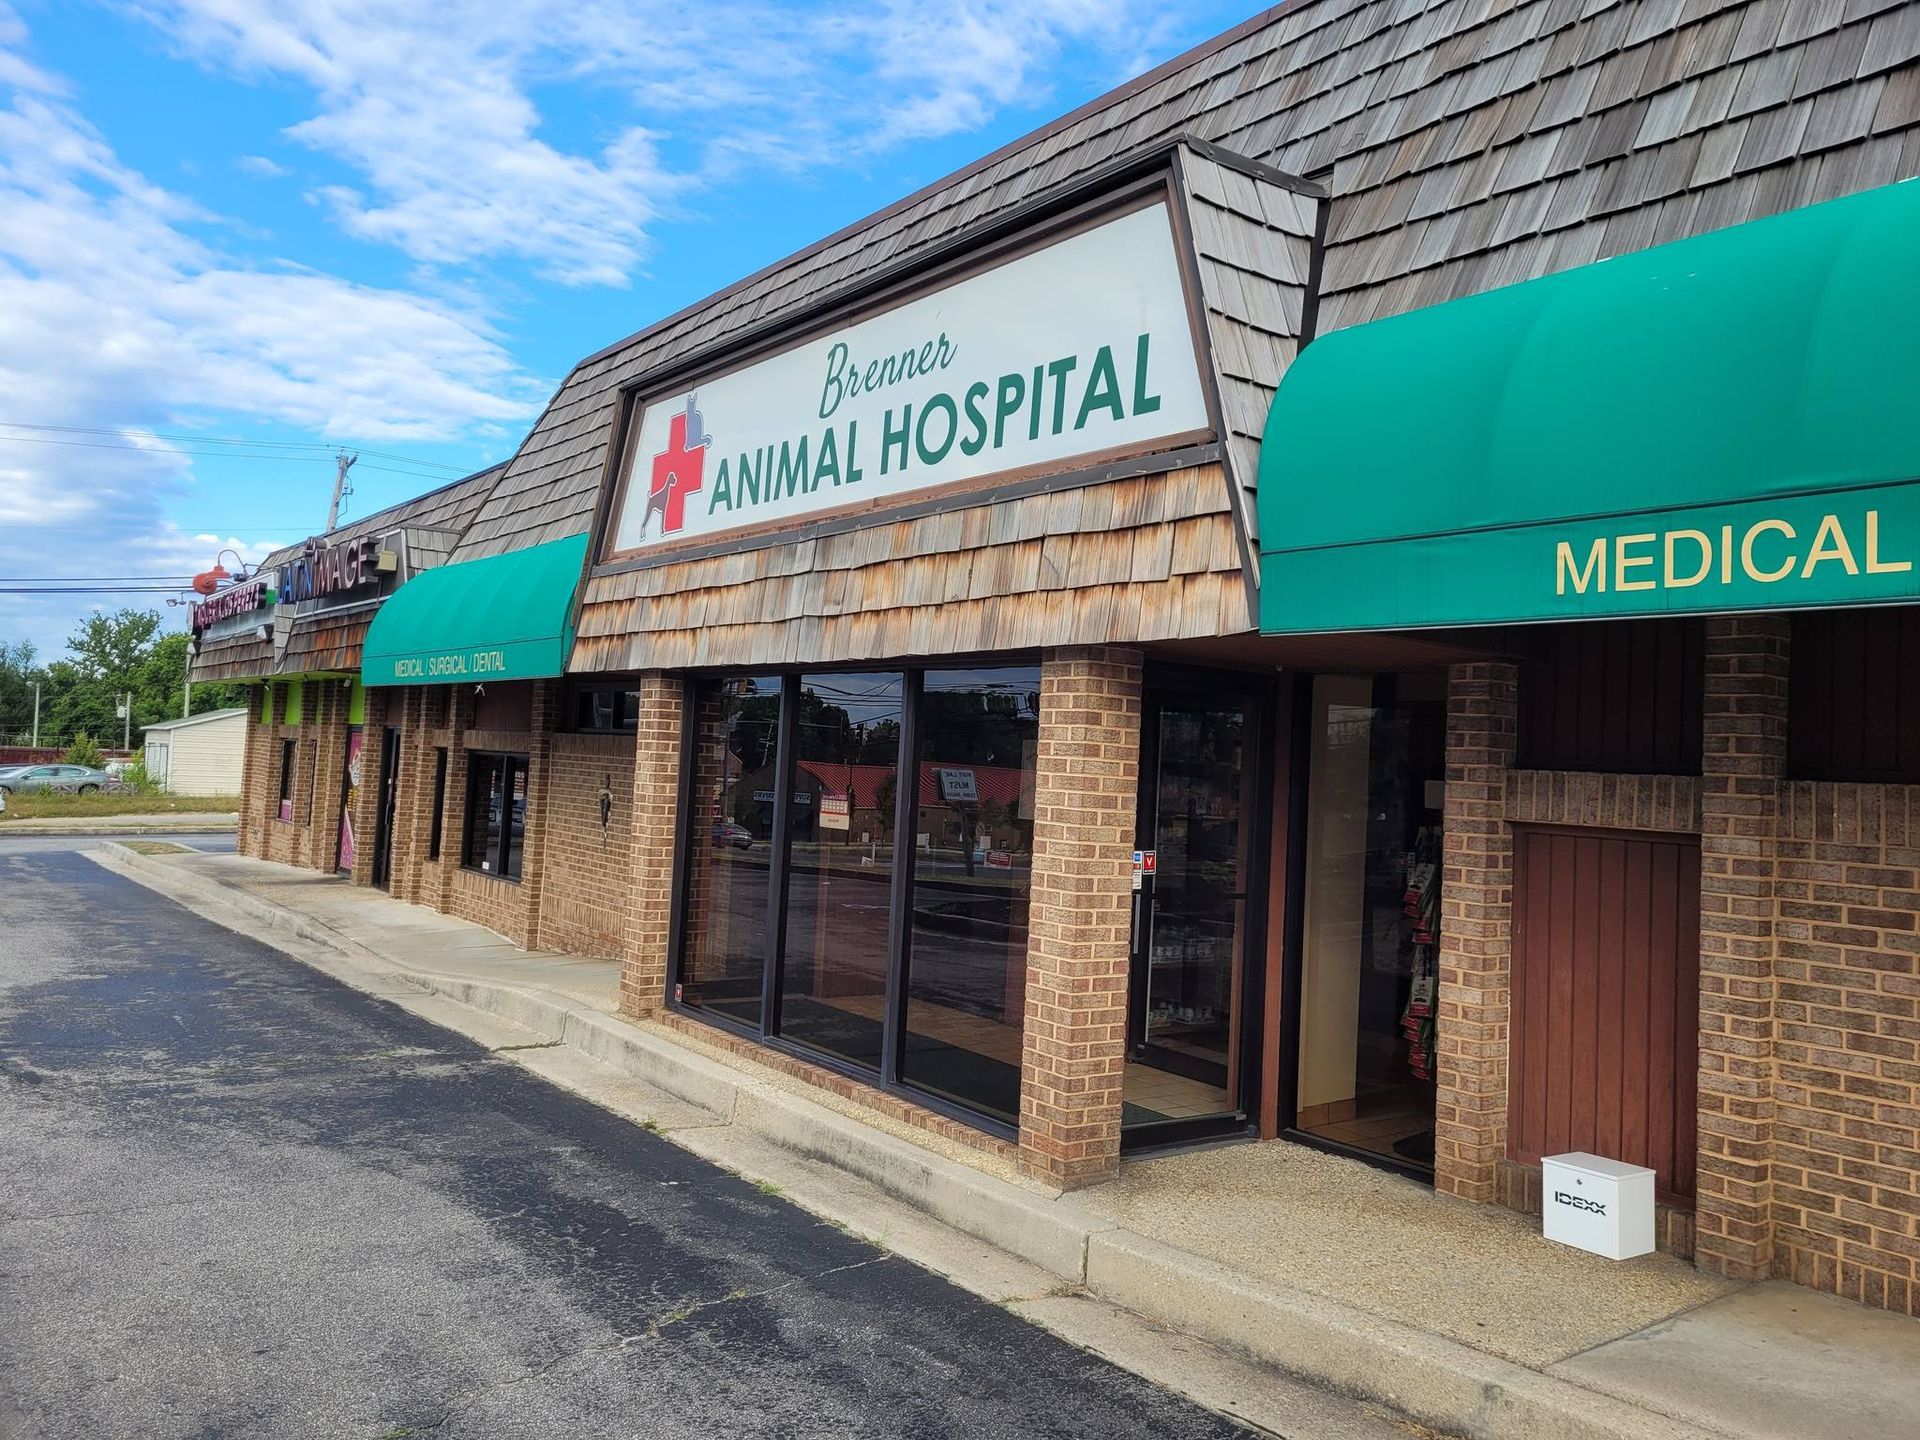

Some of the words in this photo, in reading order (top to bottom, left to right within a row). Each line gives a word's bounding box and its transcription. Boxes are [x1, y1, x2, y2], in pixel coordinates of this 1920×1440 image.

[818, 331, 959, 419] Brenner
[708, 419, 863, 516] ANIMAL
[879, 332, 1162, 476] HOSPITAL
[1556, 510, 1913, 595] MEDICAL
[395, 658, 424, 677] MEDICAL
[428, 655, 467, 676] SURGICAL
[473, 650, 506, 673] DENTAL
[1554, 1190, 1607, 1217] IDEXX
